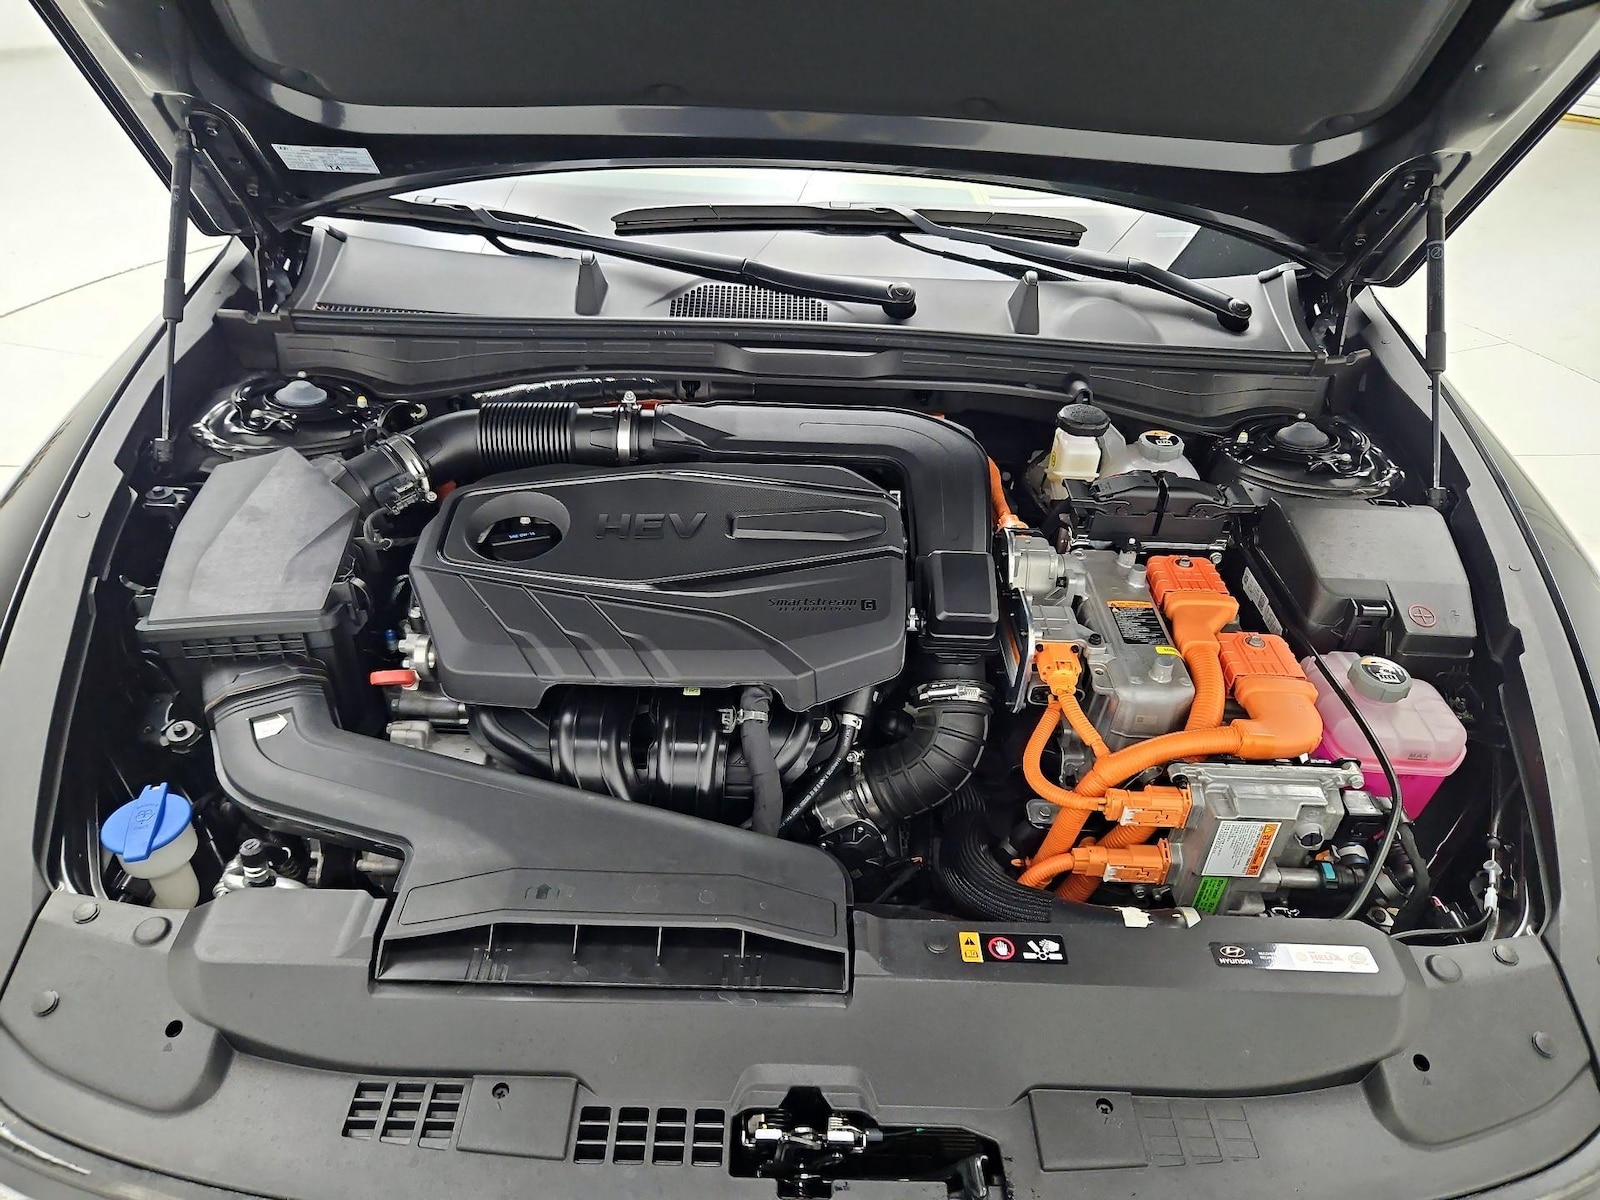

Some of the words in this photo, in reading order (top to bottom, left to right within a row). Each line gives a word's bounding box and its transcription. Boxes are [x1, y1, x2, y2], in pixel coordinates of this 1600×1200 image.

[595, 513, 707, 540] HEV
[767, 598, 857, 607] Smartstream
[1219, 957, 1253, 965] HYUNDAI
